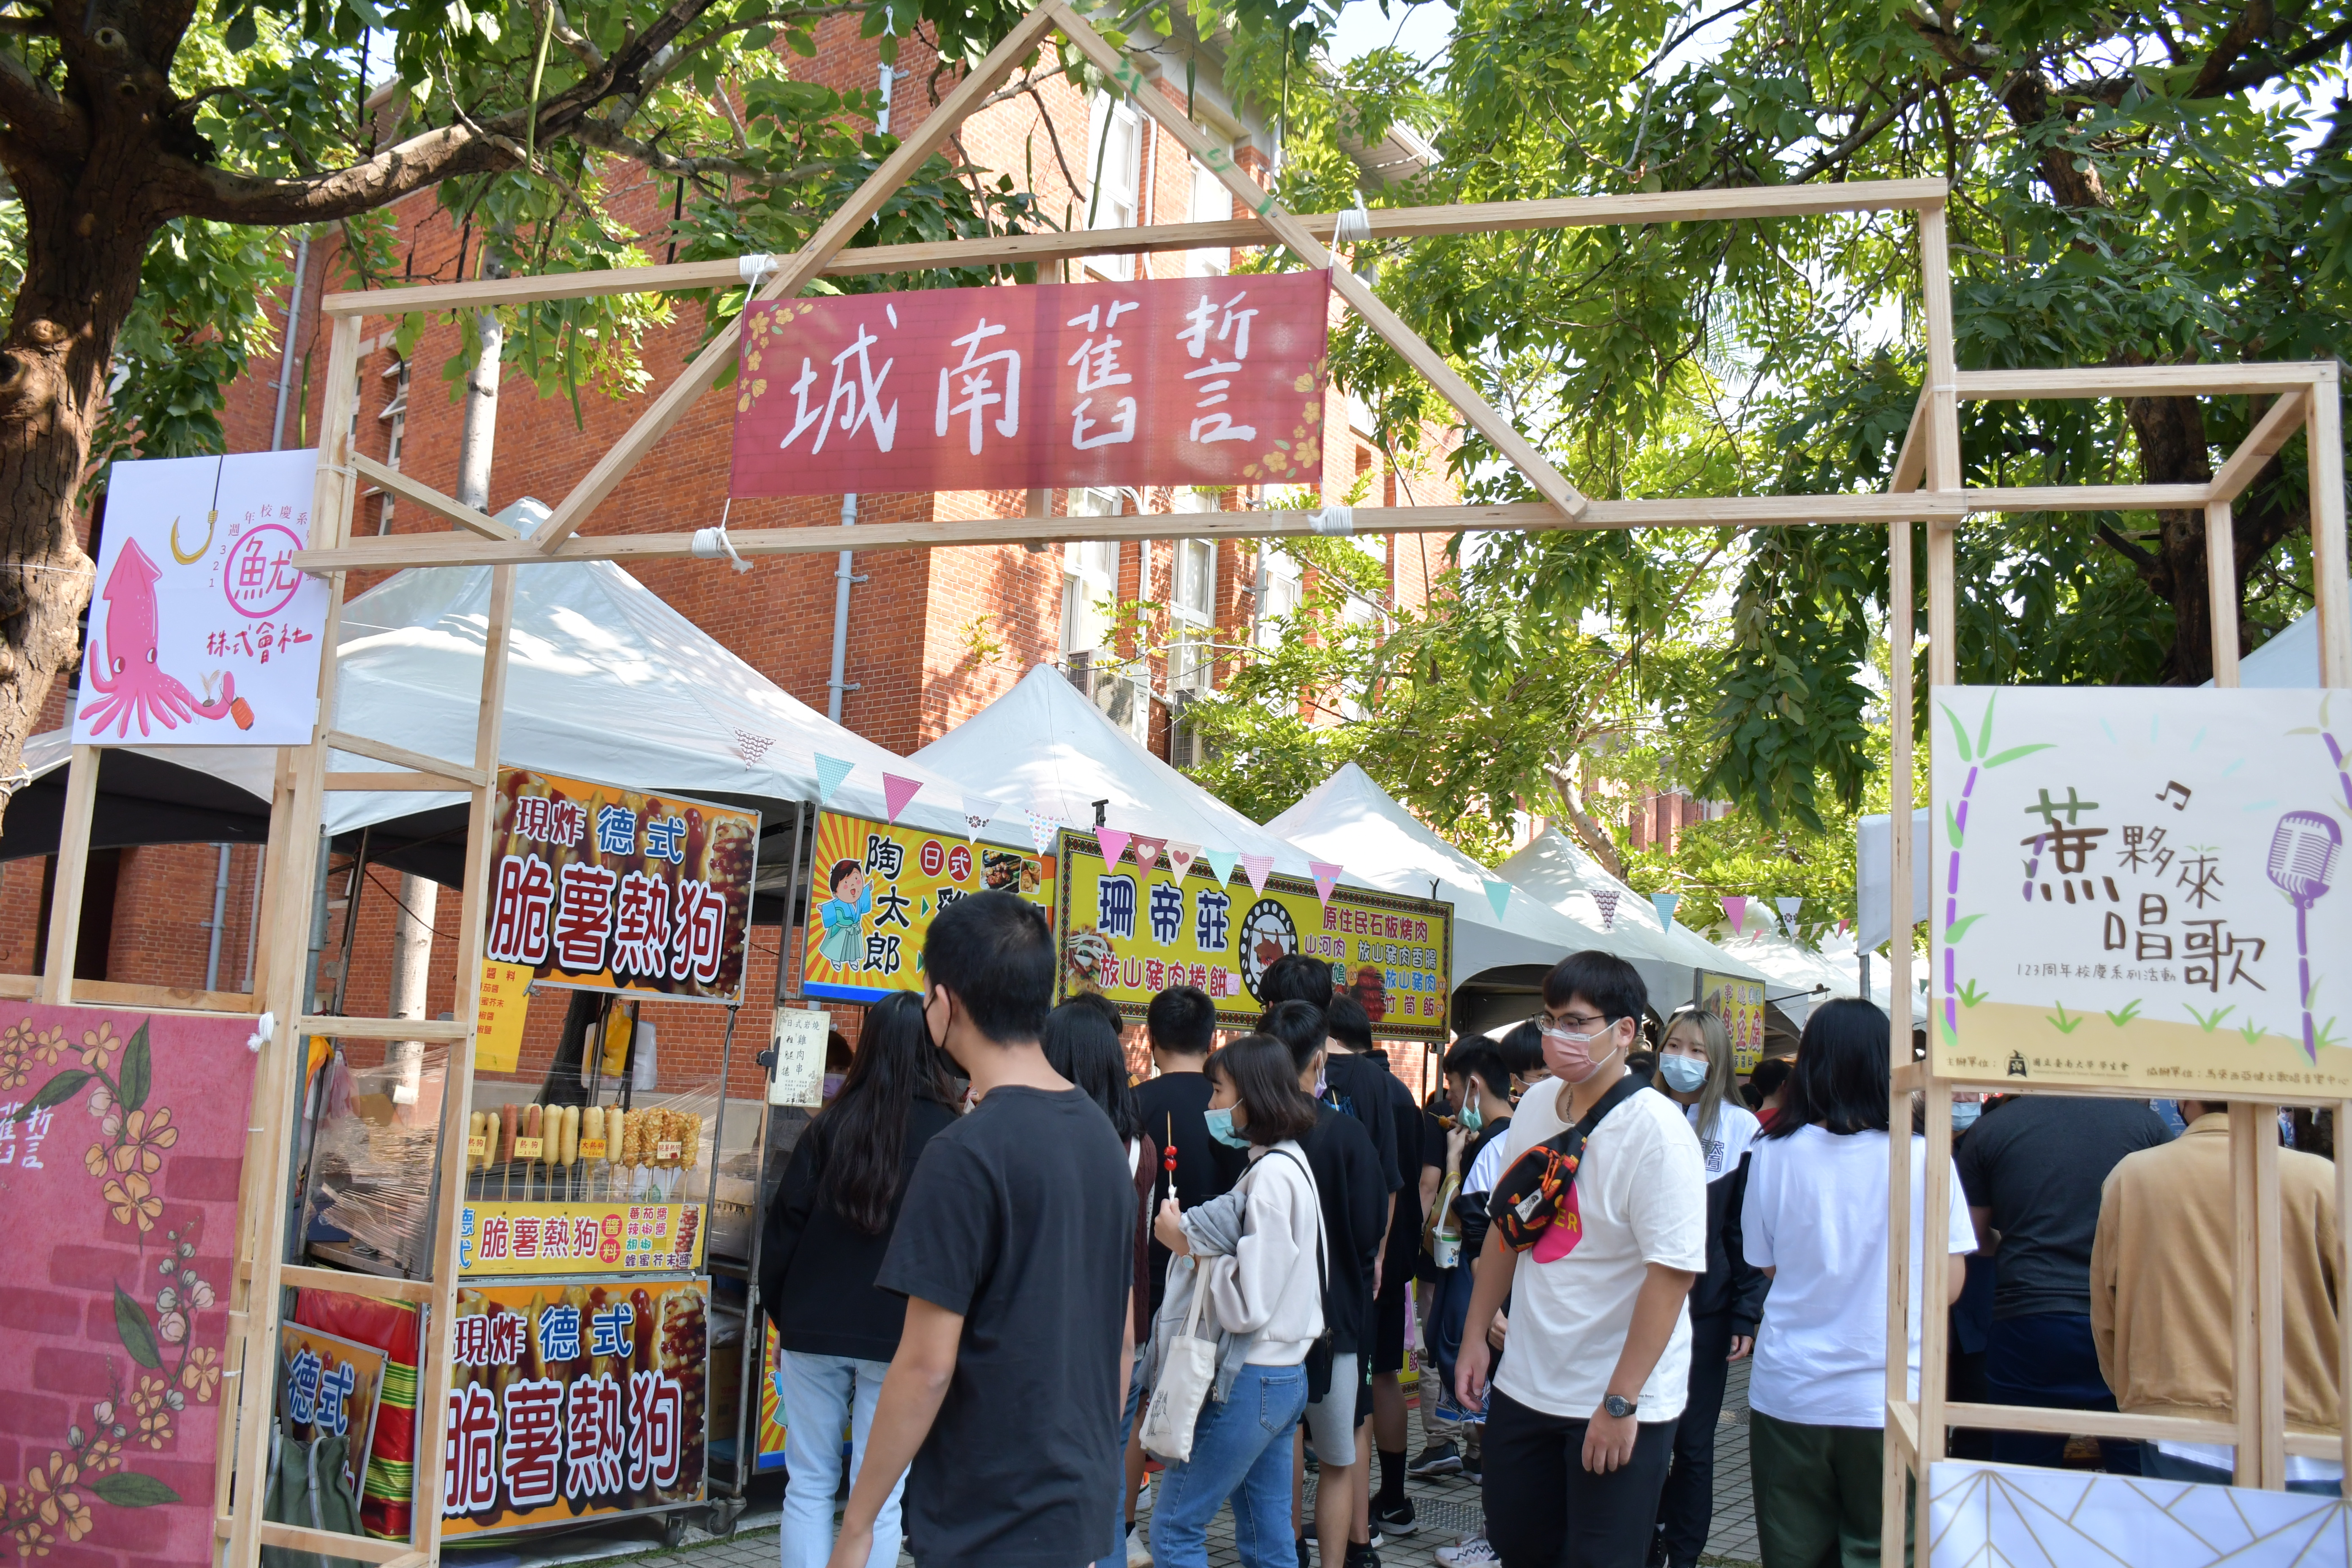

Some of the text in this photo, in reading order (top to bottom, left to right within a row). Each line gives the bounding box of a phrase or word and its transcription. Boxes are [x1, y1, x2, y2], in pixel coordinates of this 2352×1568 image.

[780, 291, 1259, 455] 城南舊誓
[234, 536, 296, 600] 魷
[207, 622, 313, 664] 株式會社
[514, 796, 686, 864] 現炸 德式
[923, 846, 970, 877] 日式
[488, 853, 726, 983] 脆薯熱狗
[865, 833, 912, 976] 陶太郎
[1097, 875, 1230, 951] 珊帝莊
[1323, 905, 1428, 943] 原住民石板烤肉
[1304, 934, 1437, 970] 山河肉 放山豬肉香腸
[2103, 893, 2267, 993] 唱歌
[487, 967, 516, 982] 醬料
[1099, 952, 1227, 998] 放山豬肉捲餅
[1347, 971, 1358, 980] 120
[1385, 968, 1436, 993] 放山豬肉
[2017, 963, 2176, 982] 123周年校慶系列活動
[479, 997, 504, 1007] 蜜芥末
[1384, 994, 1435, 1017] 竹筒飯
[1436, 1004, 1443, 1013] 60
[787, 1019, 820, 1031] 日式岩燒
[796, 1034, 806, 1075] 雞肉串
[520, 1140, 538, 1149] 熱狗
[582, 1141, 604, 1150] 大熱狗
[628, 1222, 666, 1236] 辣椒醬
[629, 1206, 668, 1220] 蕃茄醬
[479, 1216, 599, 1260] 脆薯熱狗
[603, 1218, 620, 1260] 醬料
[625, 1253, 690, 1267] 蜂蜜芥末醬
[453, 1303, 634, 1366] 現炸 德式
[443, 1369, 681, 1514] 脆薯熱狗
